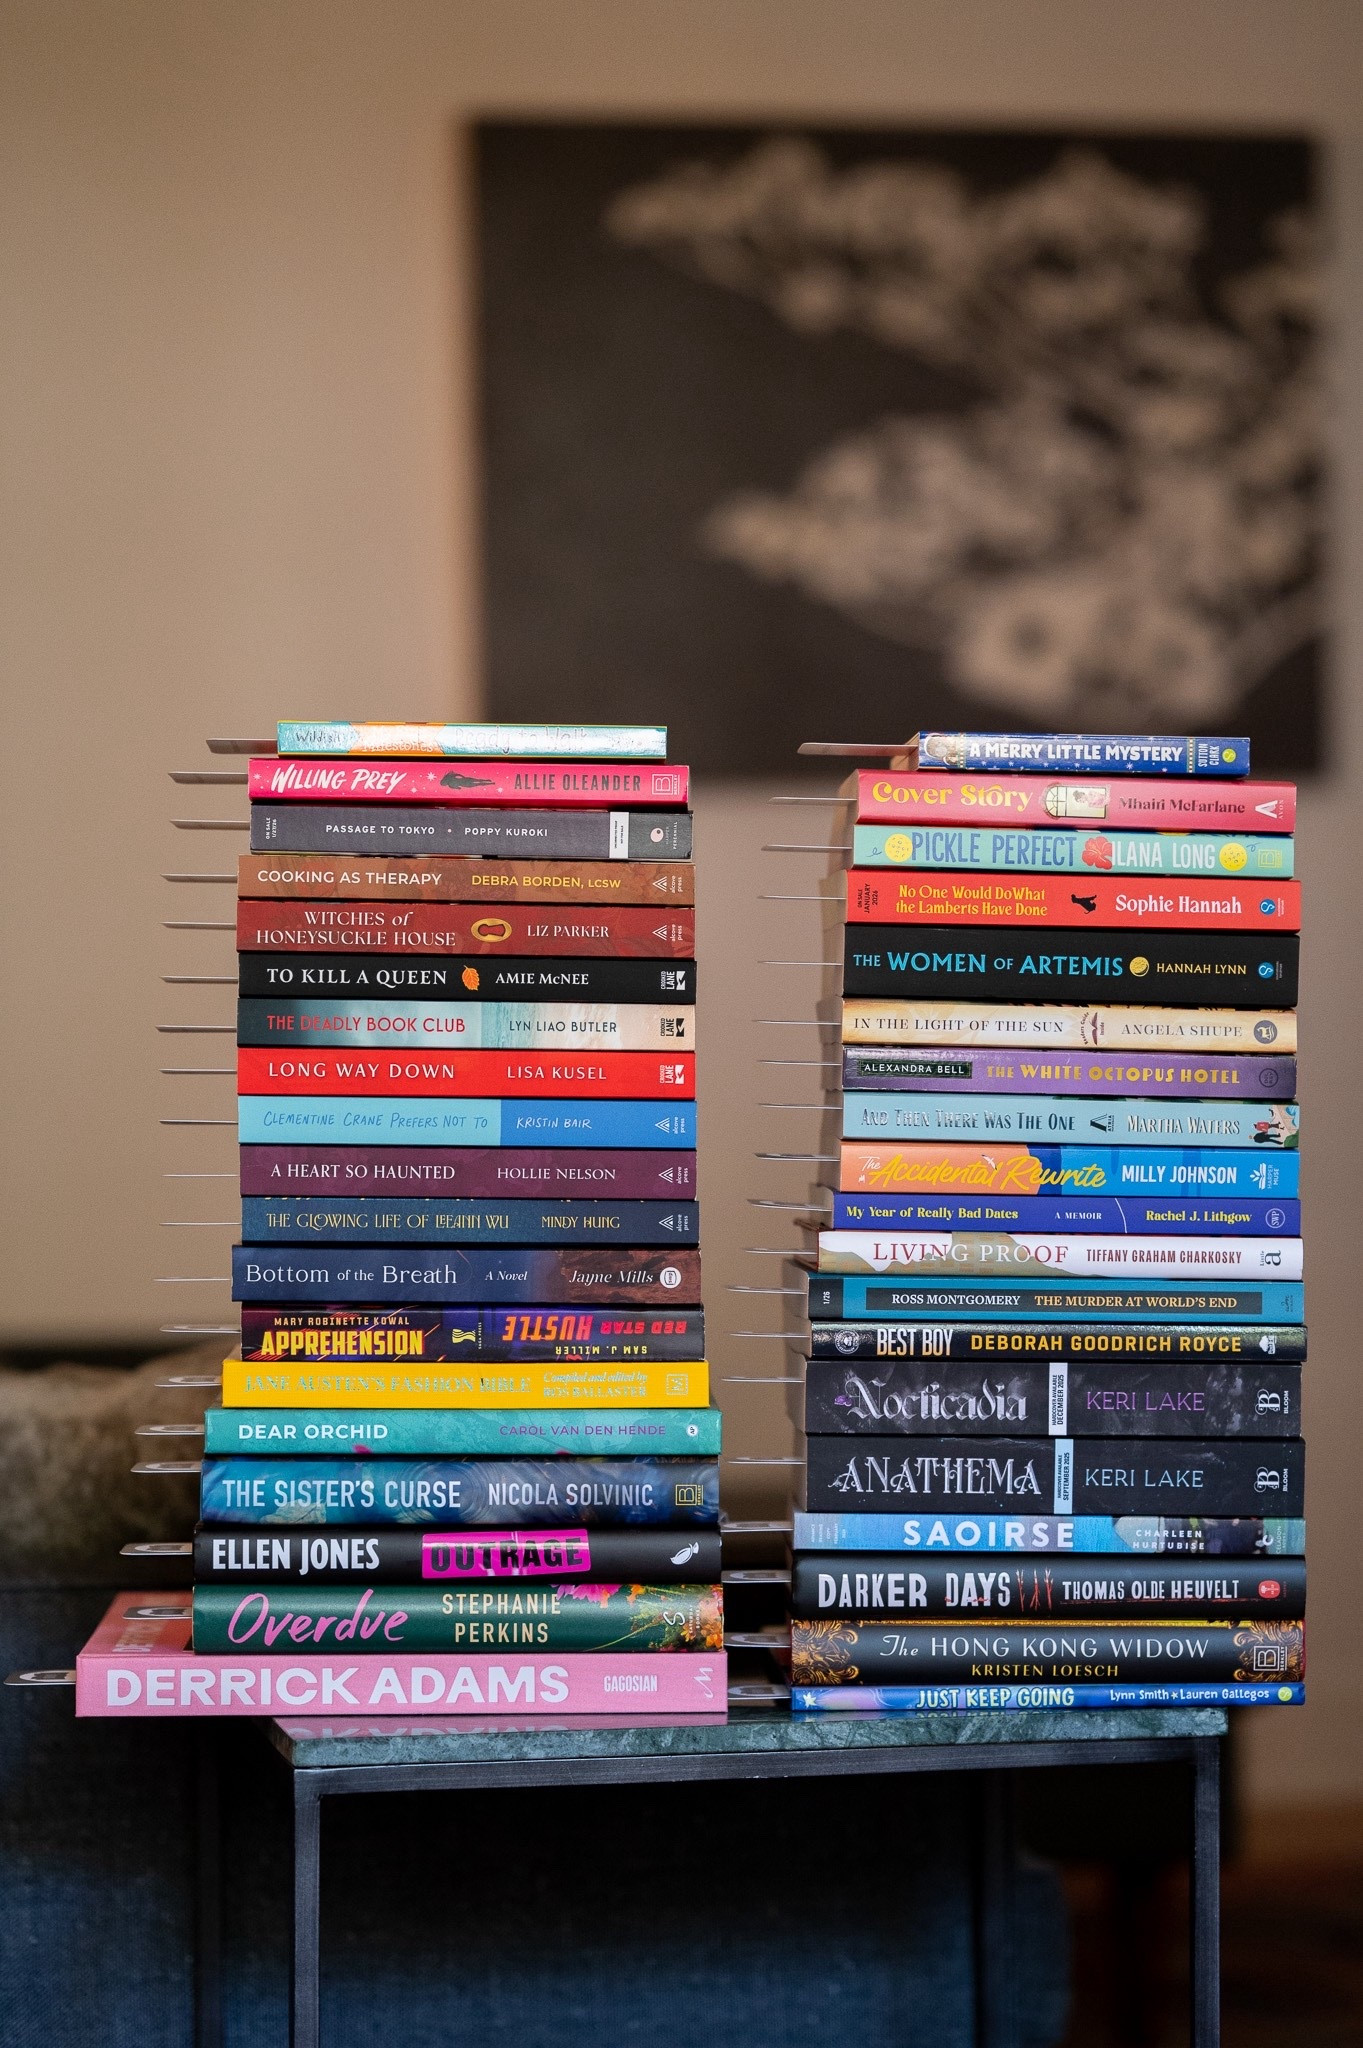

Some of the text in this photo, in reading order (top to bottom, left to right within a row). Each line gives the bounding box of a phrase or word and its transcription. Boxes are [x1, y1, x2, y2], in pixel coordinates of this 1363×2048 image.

[970, 742, 1183, 761] A MERRY LITTLE MYSTERY
[1198, 743, 1208, 767] SUTTON
[1210, 745, 1220, 765] CLARK
[271, 764, 407, 794] WILLING PREY
[514, 774, 641, 791] ALLIE OLEANDER
[872, 782, 1033, 812] Cover Story
[265, 832, 271, 840] ON
[326, 825, 376, 833] PASSAGE
[399, 826, 435, 835] TOKYO
[465, 828, 548, 836] POPPY KUROKI
[1112, 841, 1215, 868] ILANA LONG
[258, 870, 442, 885] COOKING AS THERAPY
[472, 875, 621, 889] DEBRA BORDEN, LCSW
[1115, 895, 1242, 915] Sophie Hannah
[527, 925, 609, 938] LIZ PARKER
[853, 952, 1123, 977] THE WOMEN OF ARTEMIS
[1156, 963, 1247, 975] HANNAH LYNN
[495, 973, 589, 985] AMIE McNEE
[667, 971, 675, 990] LANE
[509, 1021, 617, 1033] LYN LIAO BUTLER
[666, 1018, 674, 1036] LANE
[1121, 1024, 1242, 1037] ANGELA SHUPE
[269, 1062, 455, 1079] LONG WAY DOWN
[864, 1063, 964, 1074] ALEXANDRA BELL
[516, 1117, 592, 1129] KRISTIN BAIR
[1127, 1115, 1240, 1135] MARTHA WATERS
[497, 1167, 616, 1180] HOLLIE NELSON
[1122, 1165, 1237, 1184] MILLY JOHNSON
[541, 1216, 620, 1229] MINDY HUNG
[1065, 1211, 1102, 1220] MEMOIR
[1146, 1210, 1252, 1224] Rachel J. Lithgow
[1087, 1249, 1242, 1264] TIFFANY GRAHAM CHARKOSKY
[246, 1264, 457, 1284] Bottom of the Breath
[485, 1271, 528, 1281] A Novel
[892, 1294, 1021, 1306] ROSS MONTGOMERY
[1034, 1295, 1062, 1306] THE
[1065, 1296, 1122, 1307] MURDER
[1125, 1297, 1143, 1307] AT
[1209, 1298, 1237, 1308] END
[274, 1316, 410, 1326] MARY ROBINETTE KOWAL
[261, 1330, 423, 1356] APPREHENSION
[555, 1346, 648, 1355] SAM J. MILLER
[876, 1329, 917, 1356] BEST
[922, 1329, 954, 1356] BOY
[971, 1335, 1241, 1352] DEBORAH GOODRICH ROYCE
[1086, 1391, 1205, 1412] KERI LAKE
[238, 1424, 388, 1439] DEAR ORCHID
[500, 1426, 666, 1436] CAROL VAN DEN HENDE
[1085, 1469, 1204, 1488] KERI LAKE
[488, 1483, 653, 1506] NICOLA SOLVINIC
[1135, 1530, 1202, 1538] CHARLEEN
[429, 1537, 583, 1572] OUTRAGE
[1132, 1542, 1205, 1550] HURTUBISE
[212, 1538, 380, 1576] ELLEN JONES
[1062, 1579, 1239, 1600] THOMAS OLDE HEUVELT
[442, 1593, 561, 1615] STEPHANIE
[227, 1589, 408, 1646] Overdue
[455, 1622, 548, 1643] PERKINS
[972, 1664, 1118, 1677] KRISTEN LOESCH
[107, 1666, 569, 1706] DERRICK ADAMS
[604, 1675, 657, 1692] GAGOSIAN
[1110, 1688, 1269, 1701] Lynn Smith Lauren Gallegos
